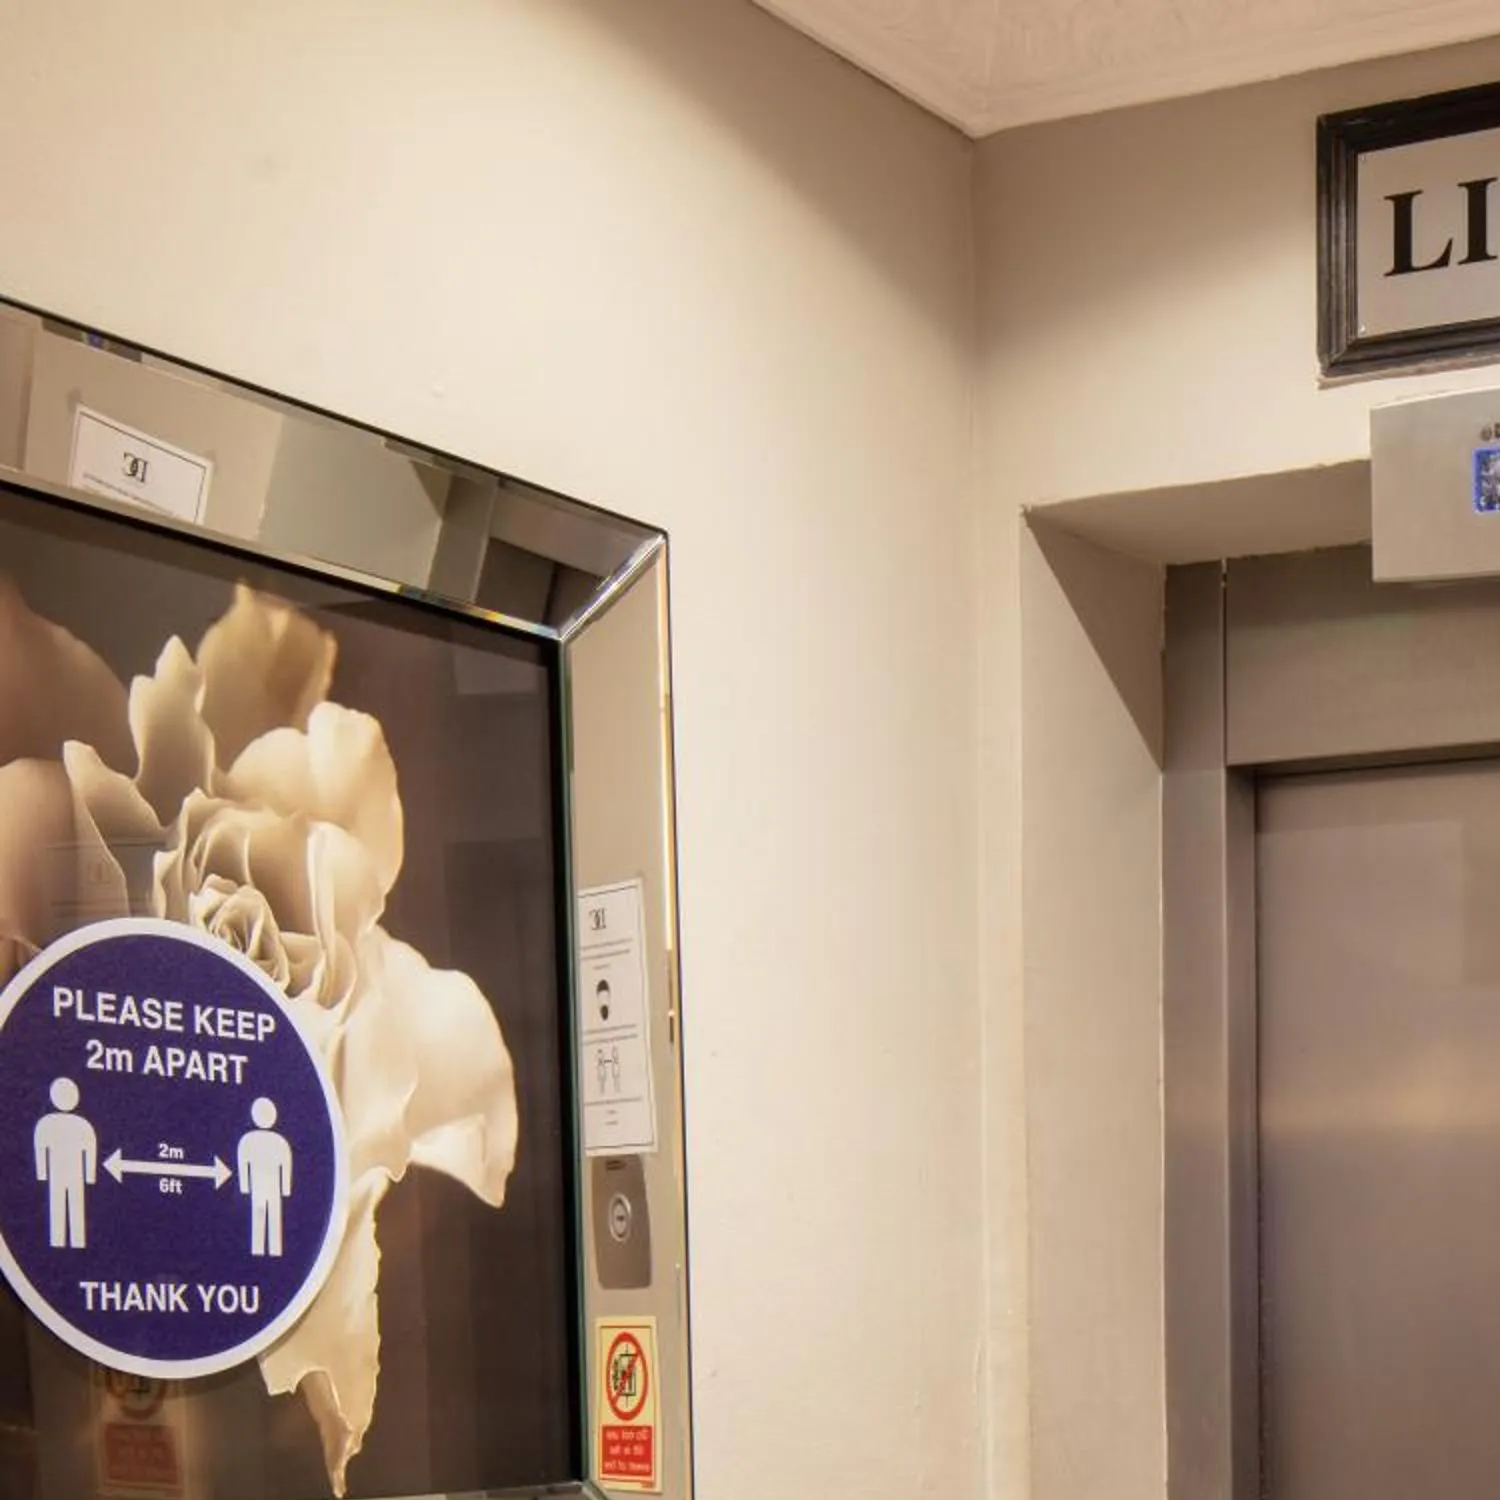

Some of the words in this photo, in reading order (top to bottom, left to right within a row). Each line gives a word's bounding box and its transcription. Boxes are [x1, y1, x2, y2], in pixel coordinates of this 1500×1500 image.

[53, 986, 184, 1032] PLEASE
[194, 1006, 277, 1042] KEEP
[86, 1039, 134, 1073] 2m
[143, 1046, 249, 1085] APART
[158, 1143, 184, 1160] 2m
[158, 1178, 183, 1195] 6ft
[80, 1281, 189, 1313] THANK
[197, 1284, 260, 1314] YOU
